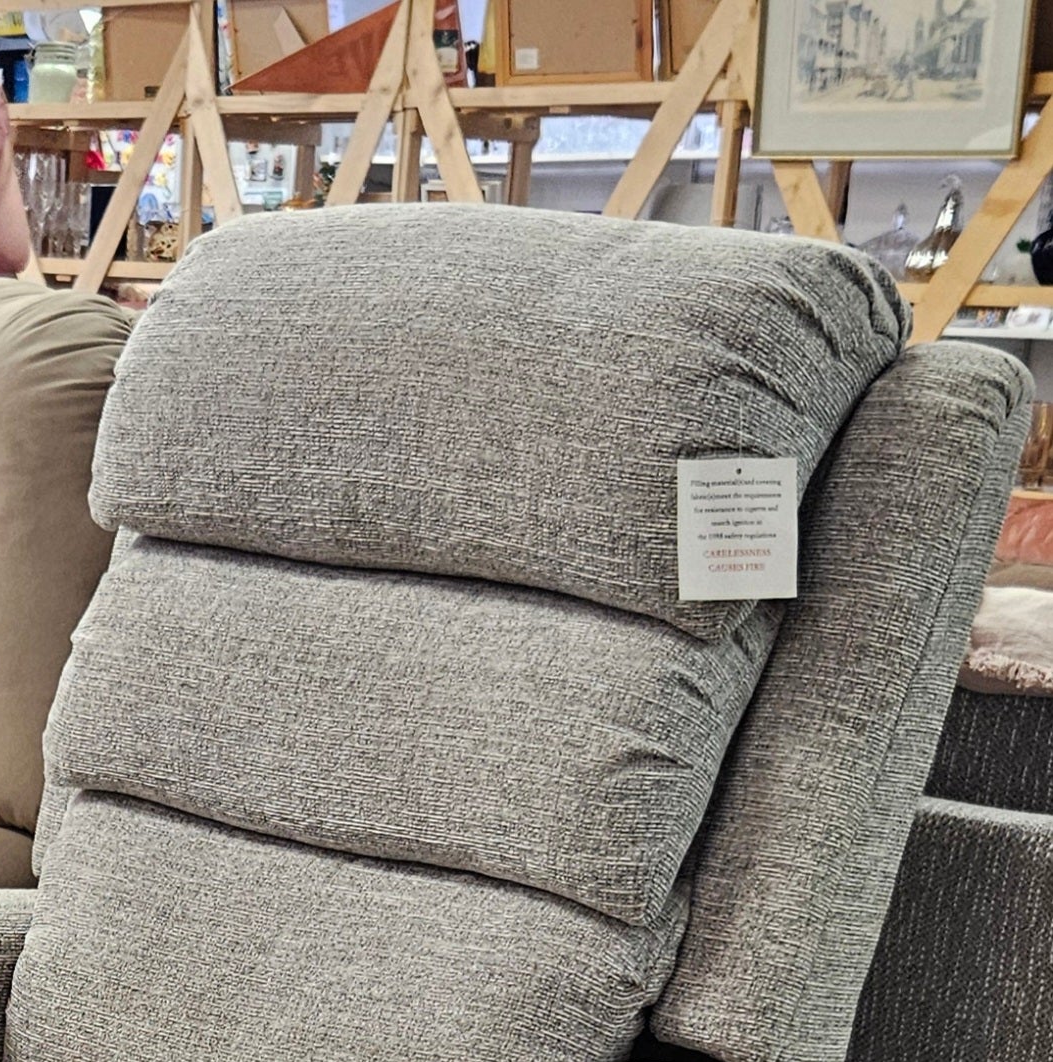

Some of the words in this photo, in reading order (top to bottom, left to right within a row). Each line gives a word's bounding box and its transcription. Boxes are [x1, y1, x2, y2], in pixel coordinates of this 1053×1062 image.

[724, 532, 743, 540] safety
[703, 548, 771, 558] CARELESSNESS
[708, 562, 744, 572] CAUSES
[745, 562, 765, 571] FIRE
